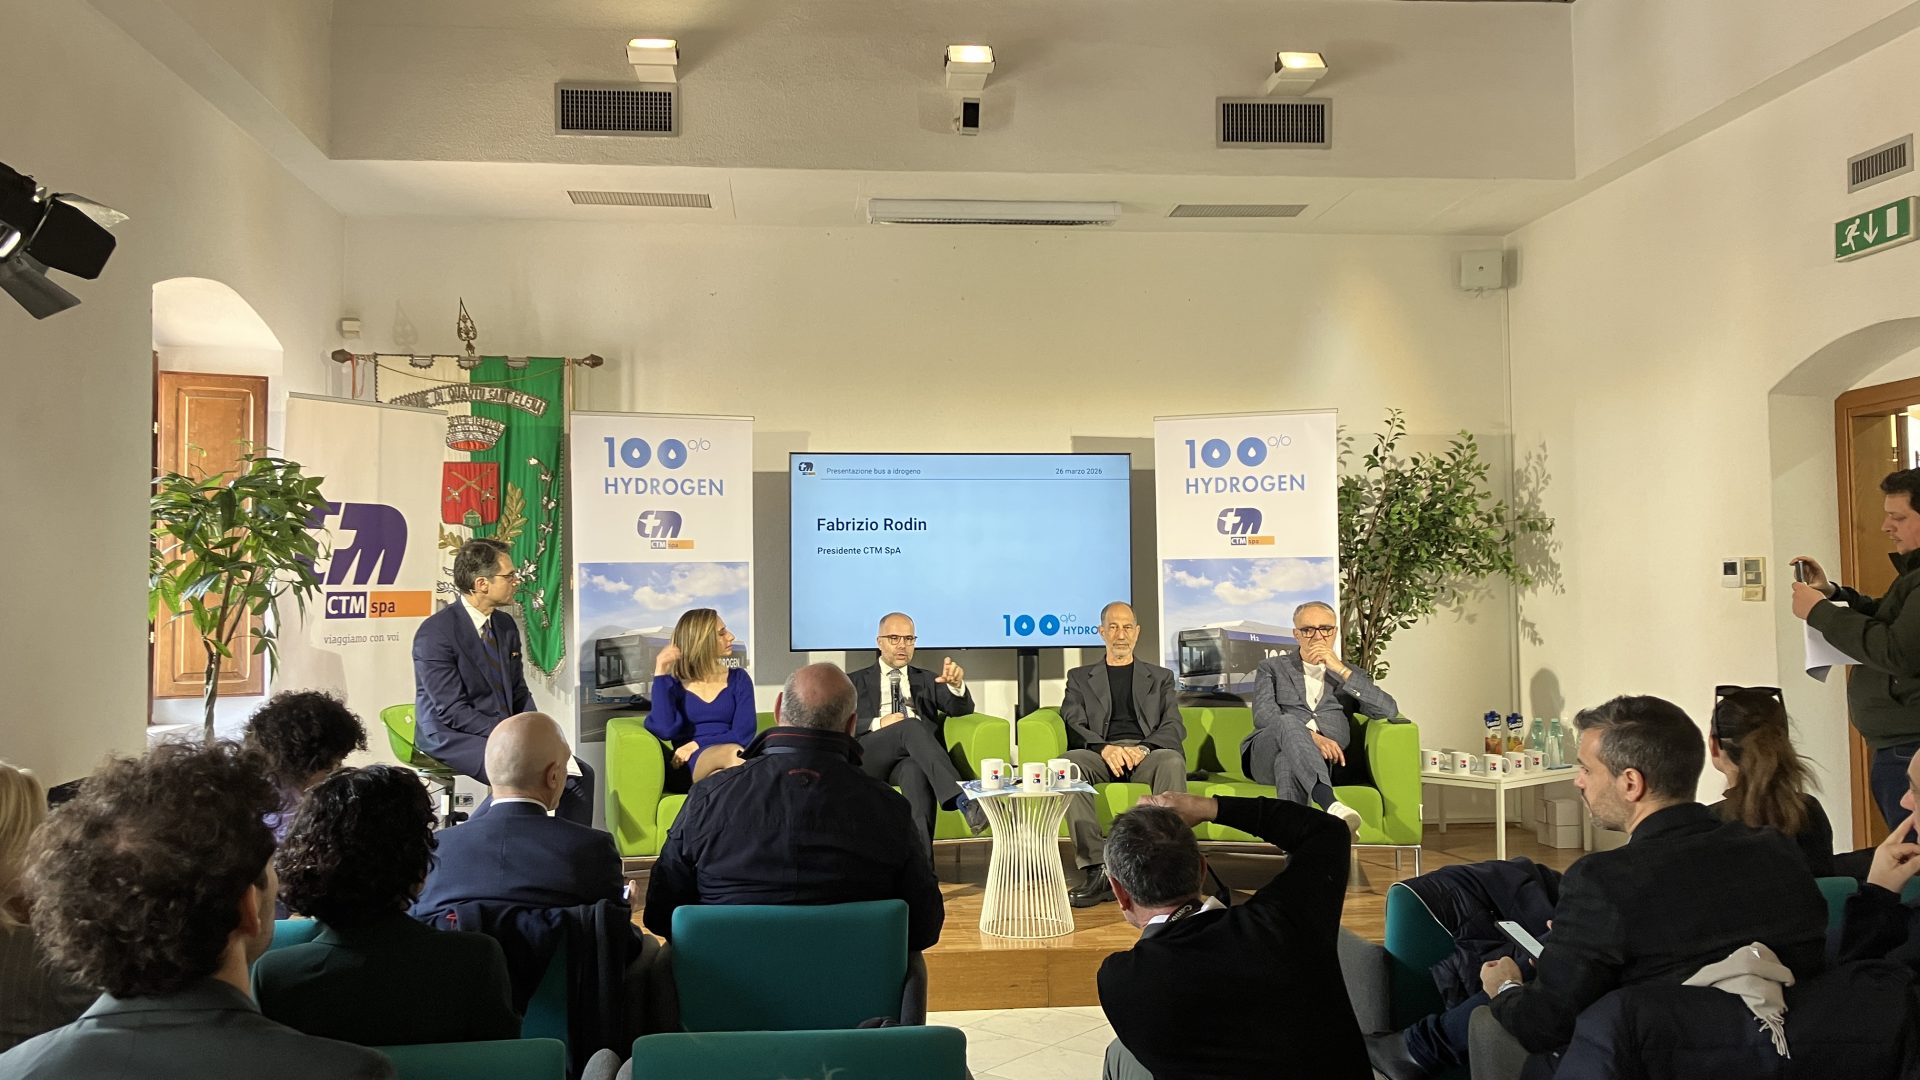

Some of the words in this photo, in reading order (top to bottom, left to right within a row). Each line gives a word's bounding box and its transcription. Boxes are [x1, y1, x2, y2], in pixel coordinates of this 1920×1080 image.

[603, 437, 711, 470] 100%
[1185, 434, 1291, 469] 100%
[826, 467, 873, 475] Presentazione
[873, 467, 886, 475] bus
[892, 467, 921, 477] idrogeno
[604, 477, 724, 496] HYDROGEN
[1185, 474, 1305, 495] HYDROGEN
[817, 517, 879, 531] Fabrizio
[883, 517, 927, 531] Rodin
[651, 540, 667, 549] CTM
[1231, 537, 1247, 545] CTM
[817, 546, 861, 555] Presidente
[863, 546, 883, 555] CTM
[884, 546, 902, 556] SpA
[326, 595, 366, 615] CTM
[370, 600, 396, 617] spa
[1063, 626, 1099, 635] HYDRO
[323, 633, 368, 646] viaggiamo
[369, 633, 385, 643] con
[386, 631, 400, 642] voi
[1170, 904, 1193, 922] Cano
